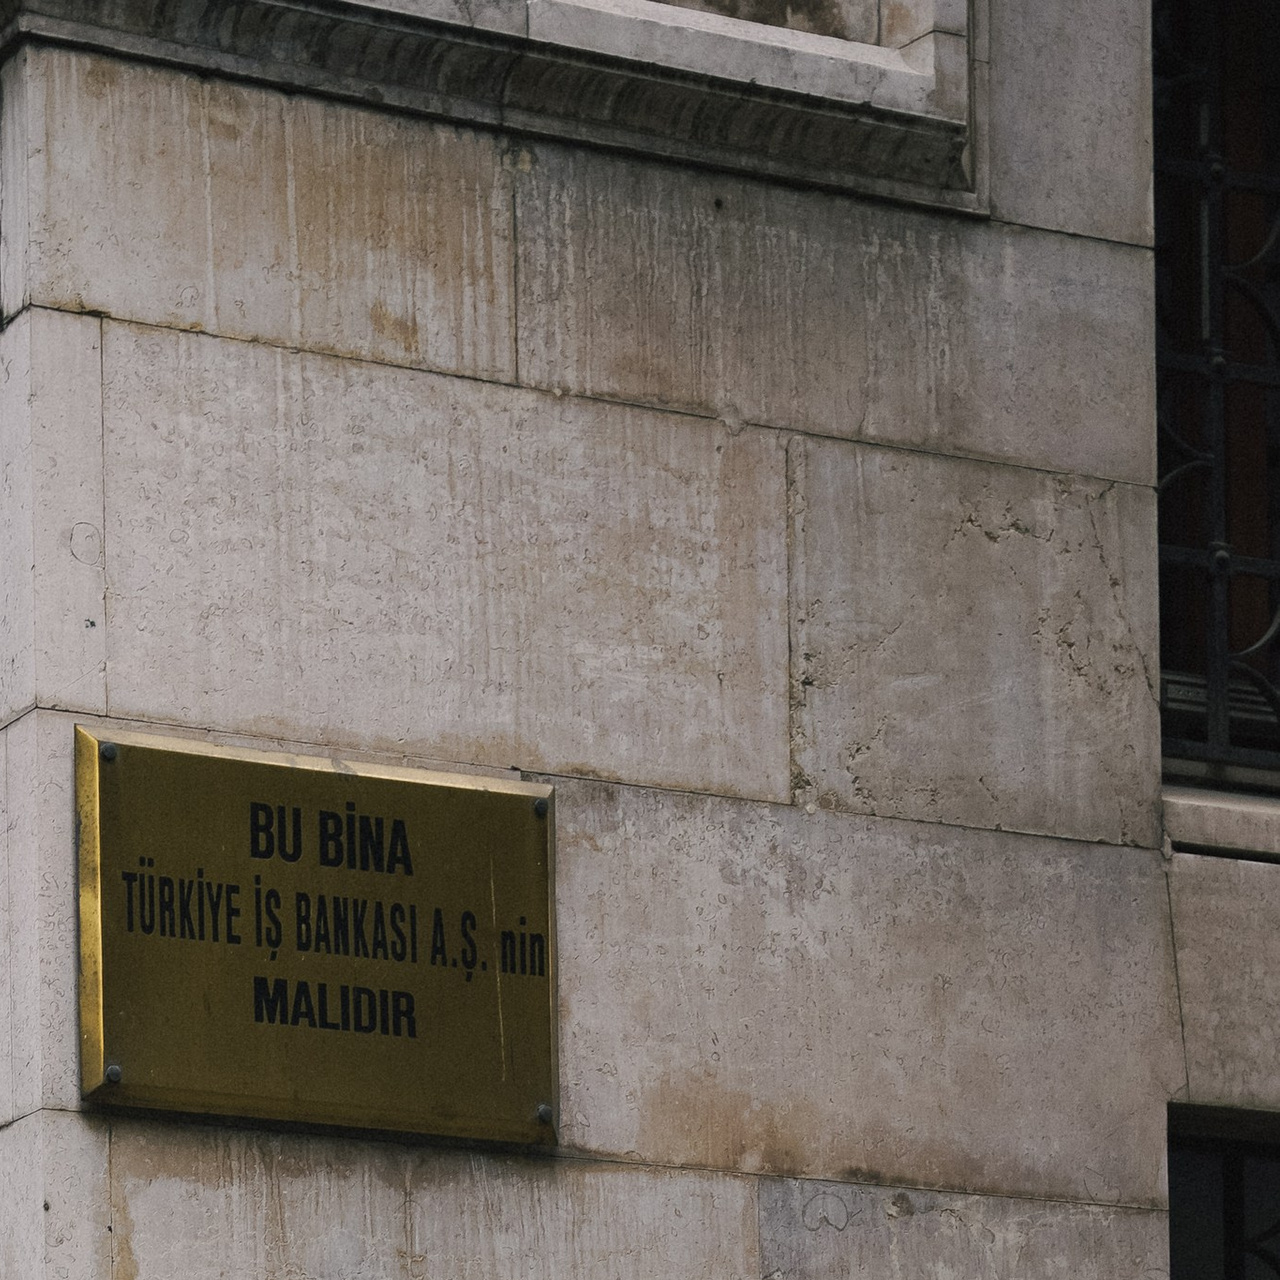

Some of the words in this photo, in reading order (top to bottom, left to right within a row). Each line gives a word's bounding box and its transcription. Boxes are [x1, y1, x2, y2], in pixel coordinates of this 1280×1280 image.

[250, 802, 302, 863] BU
[320, 802, 414, 876] BİNA
[122, 857, 241, 945] TÜRKİYE
[255, 875, 282, 961] İŞ
[296, 892, 418, 964] BANKASI
[431, 908, 488, 982] A.Ş.
[501, 916, 546, 977] nin
[253, 976, 417, 1039] MALIDIR
